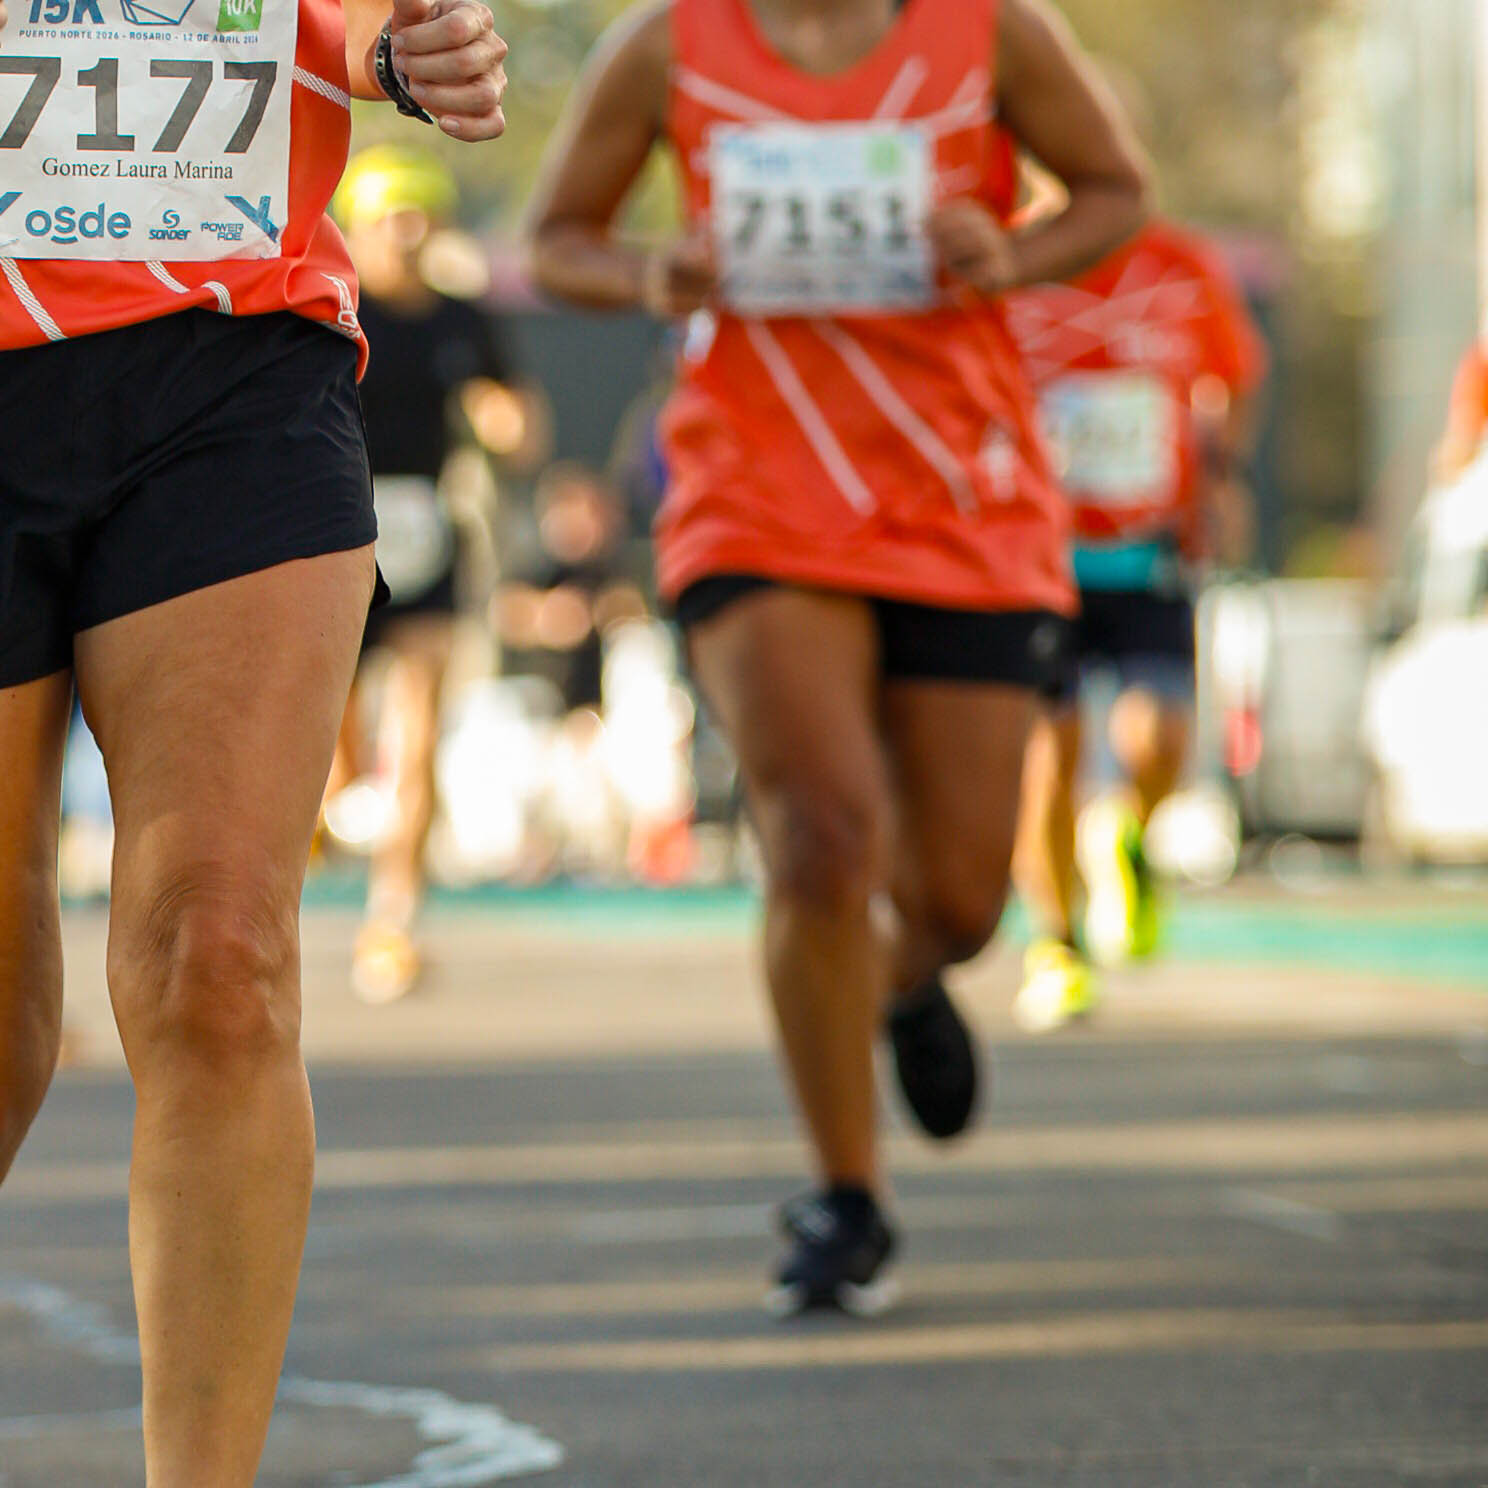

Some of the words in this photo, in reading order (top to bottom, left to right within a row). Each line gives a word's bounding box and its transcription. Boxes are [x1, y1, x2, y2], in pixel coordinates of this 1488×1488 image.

[19, 29, 57, 38] PUERTO
[60, 30, 92, 40] NORTE
[129, 31, 172, 41] ROSARIO
[197, 33, 209, 42] DE
[213, 33, 240, 44] ABRIL
[42, 157, 110, 177] Gomez
[116, 159, 168, 178] Laura
[173, 160, 233, 180] Marina
[25, 201, 132, 240] osde
[200, 221, 244, 233] POWER
[730, 188, 911, 255] 7151
